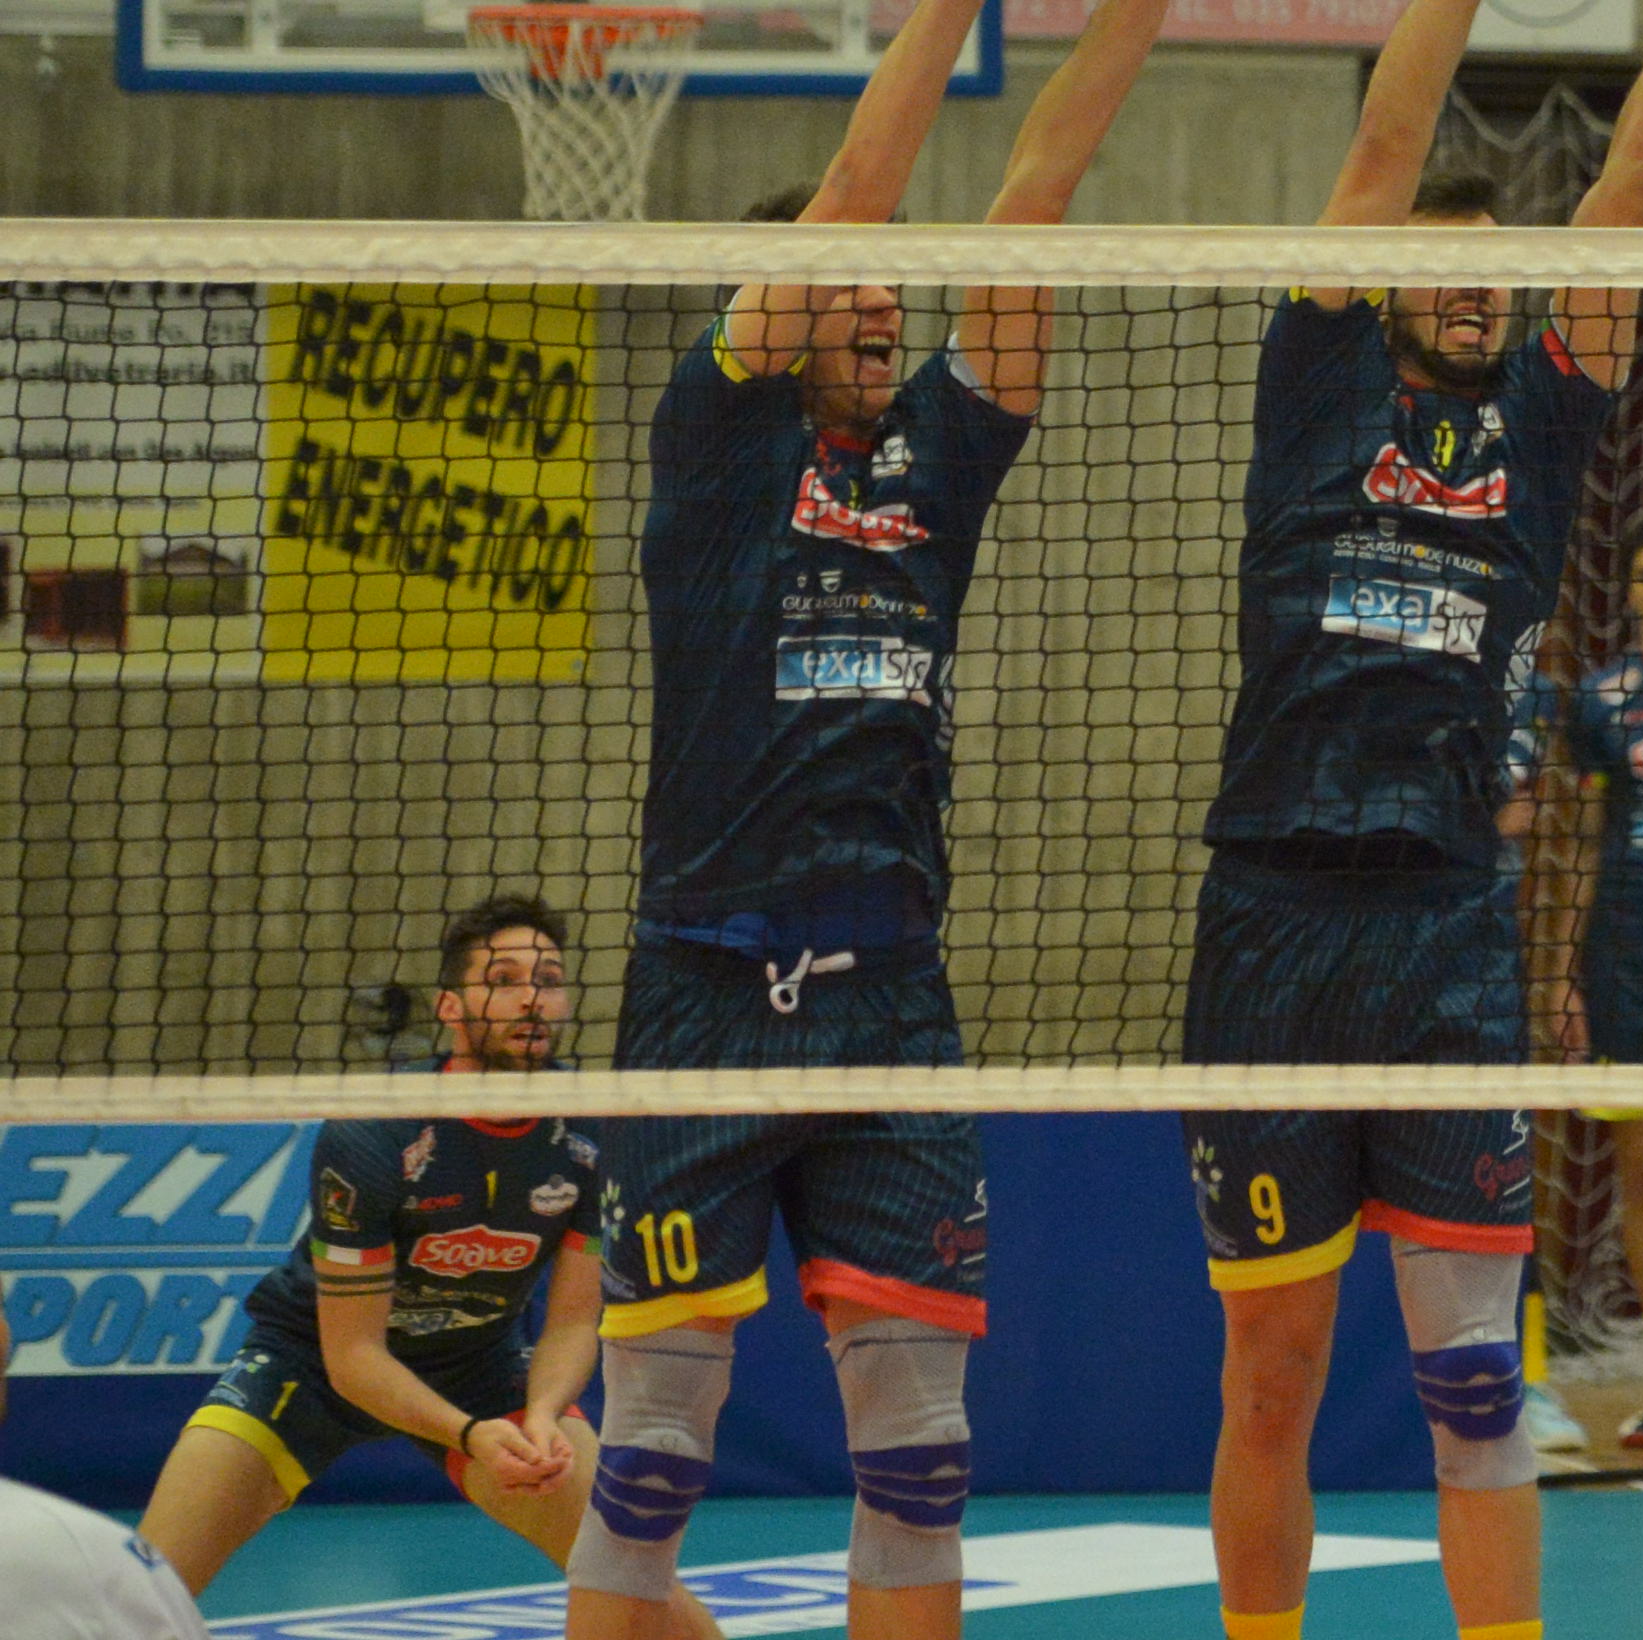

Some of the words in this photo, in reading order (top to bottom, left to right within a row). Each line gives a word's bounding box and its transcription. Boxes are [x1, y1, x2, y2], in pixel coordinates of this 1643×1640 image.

[285, 288, 578, 456] RECUPERO
[274, 436, 583, 611] ENERGETICO
[635, 1209, 699, 1287] 10
[1248, 1173, 1286, 1245] 9
[420, 1238, 529, 1268] Soave
